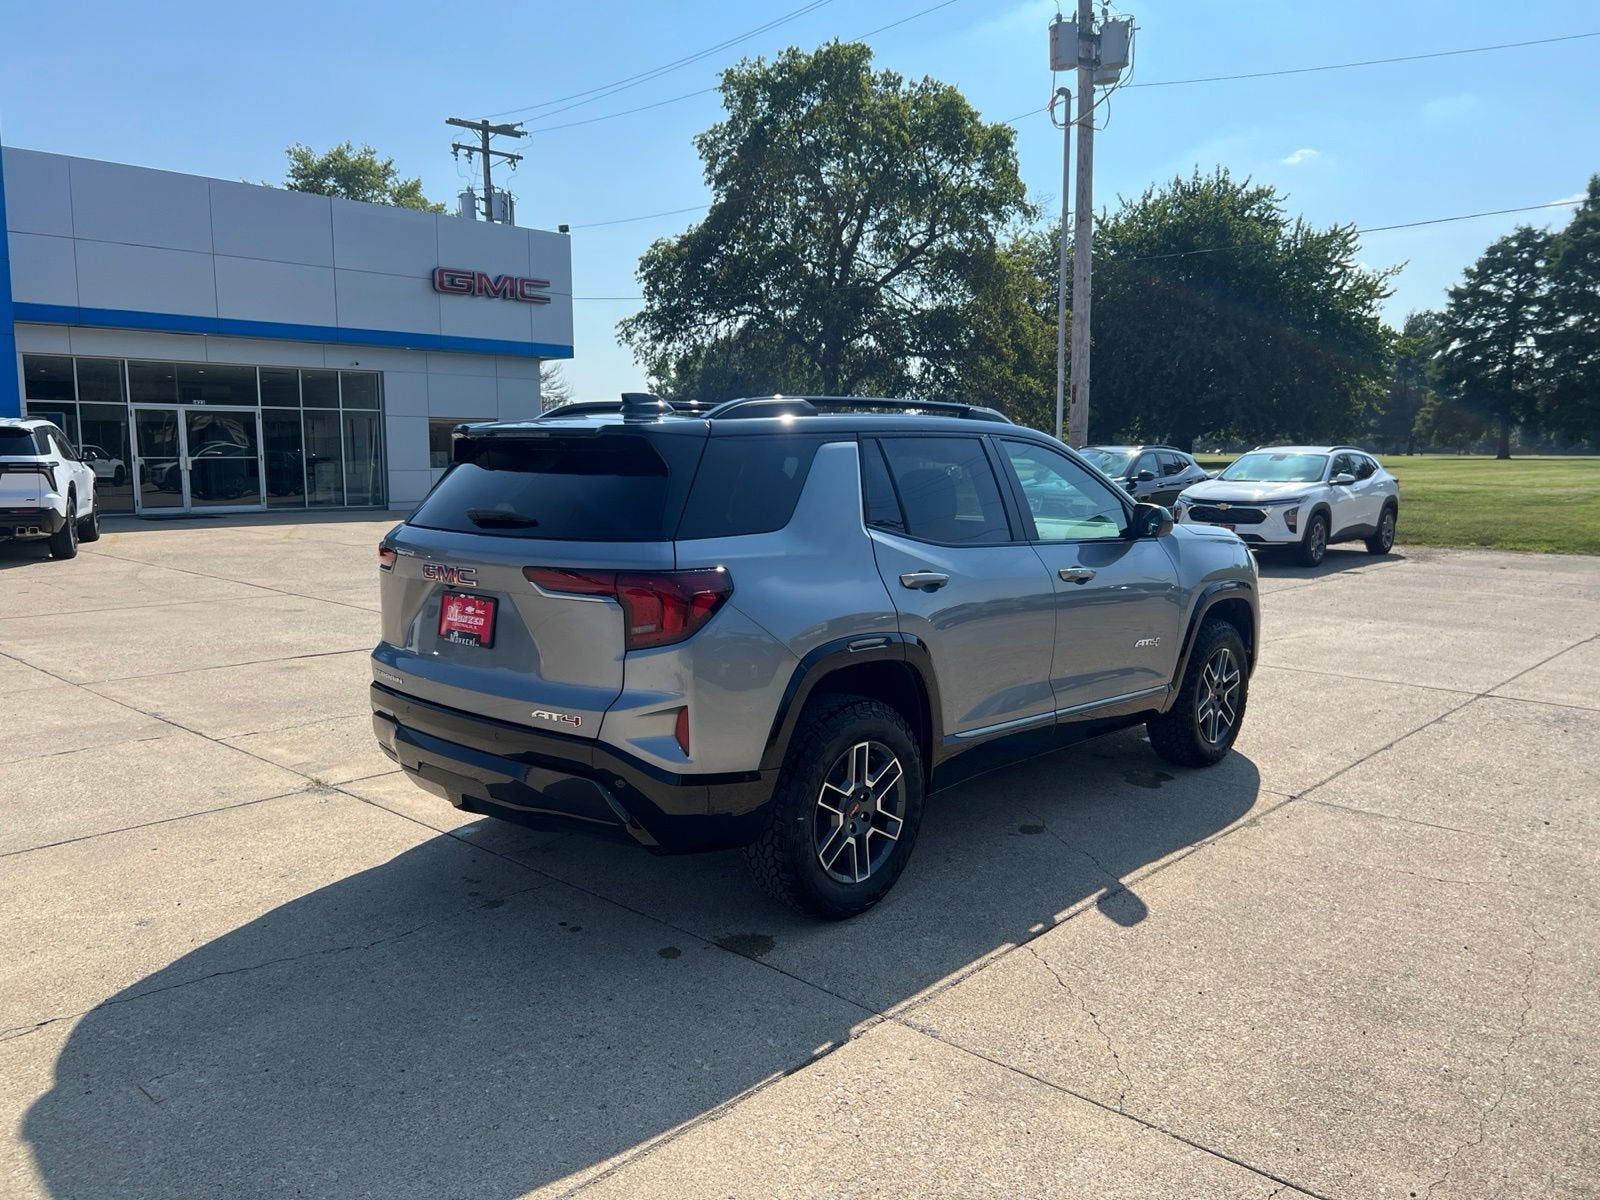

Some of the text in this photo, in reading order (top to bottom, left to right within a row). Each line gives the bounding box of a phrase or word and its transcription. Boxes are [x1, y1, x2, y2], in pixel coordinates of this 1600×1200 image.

[432, 266, 551, 304] GMC
[422, 562, 478, 587] GMC
[1134, 636, 1161, 648] AT4
[531, 709, 582, 728] AT4
